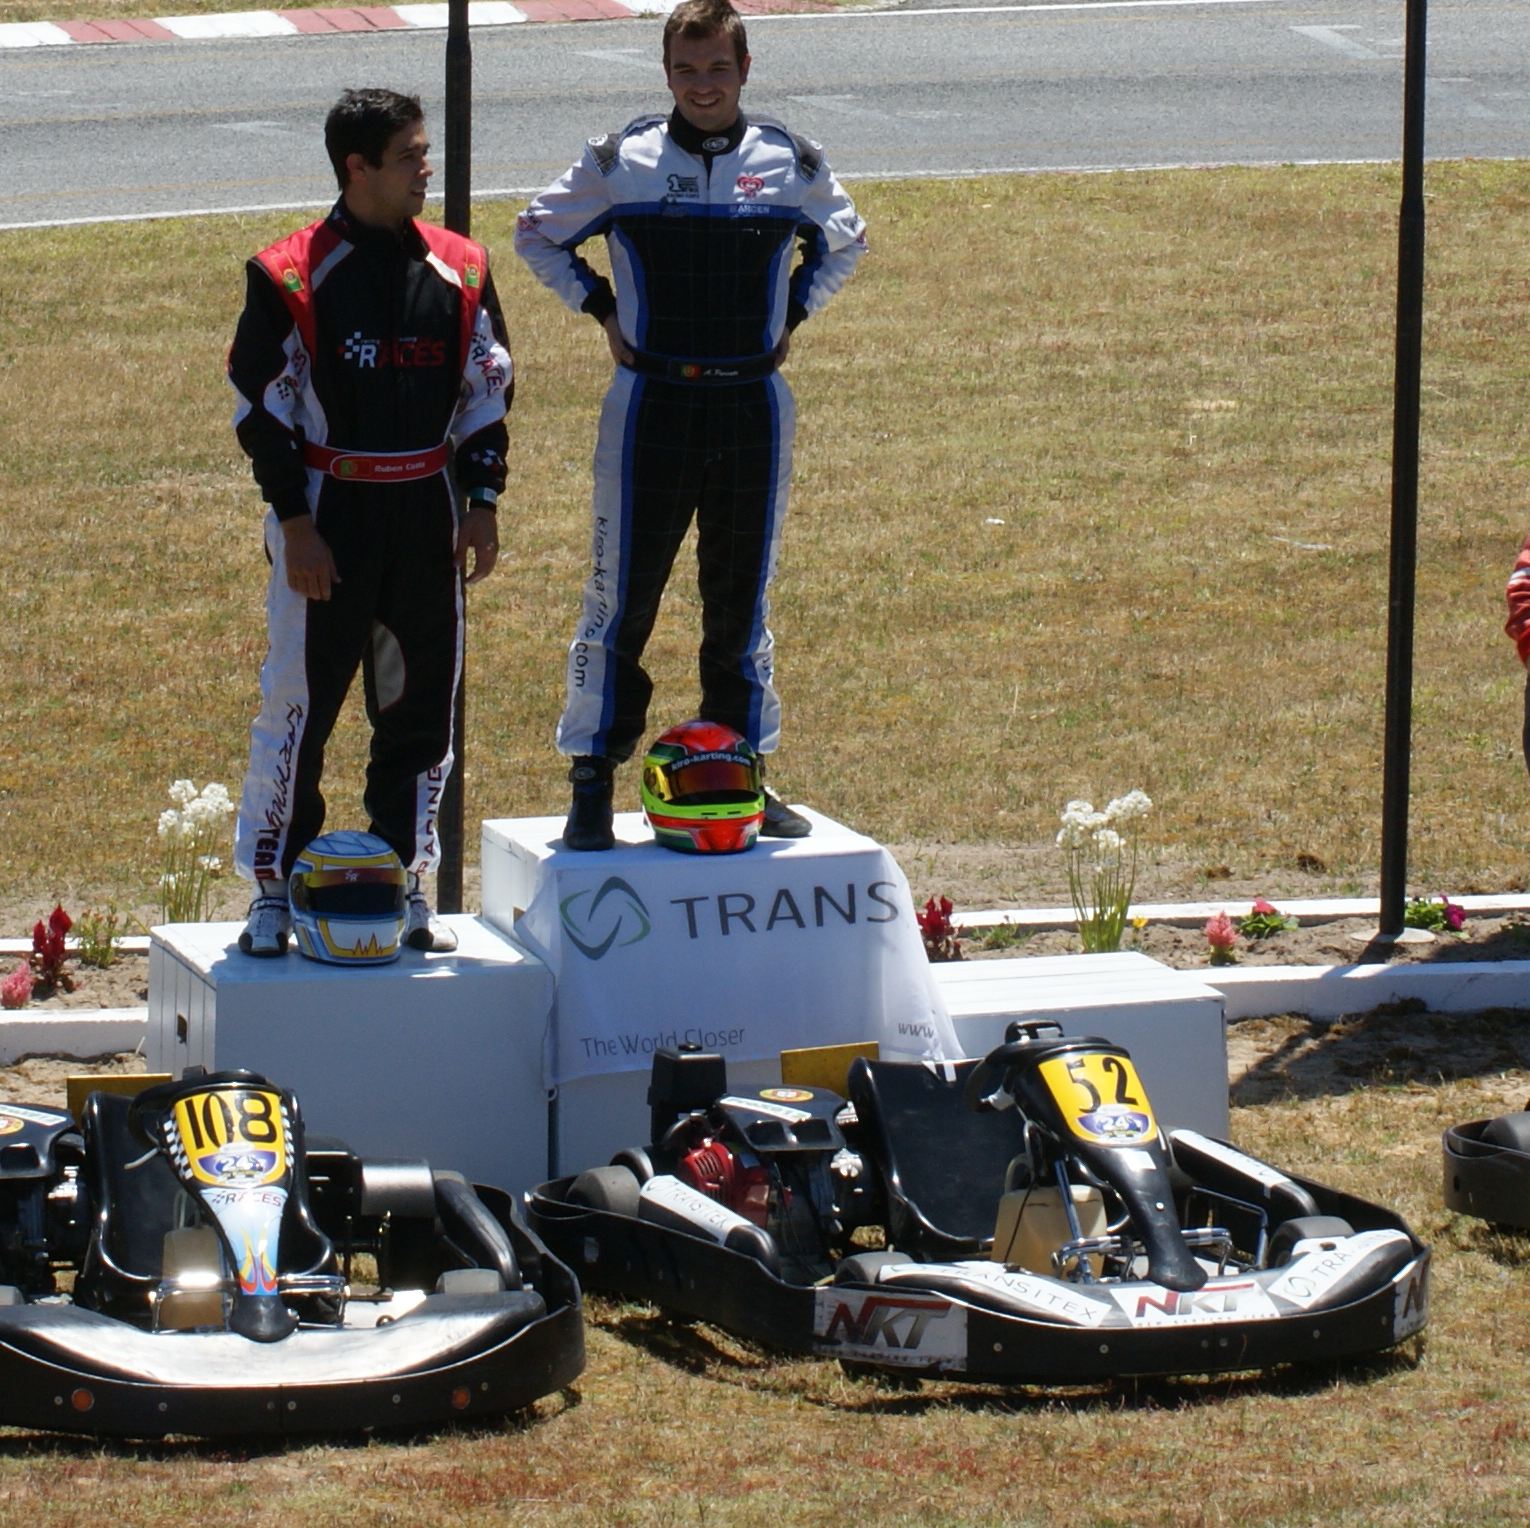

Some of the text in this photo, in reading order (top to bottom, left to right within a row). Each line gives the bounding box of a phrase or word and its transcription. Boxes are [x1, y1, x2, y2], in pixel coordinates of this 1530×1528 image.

[358, 339, 447, 369] RACES
[581, 1027, 746, 1058] The World Closer
[1066, 1056, 1139, 1114] 52
[185, 1091, 278, 1151] 108
